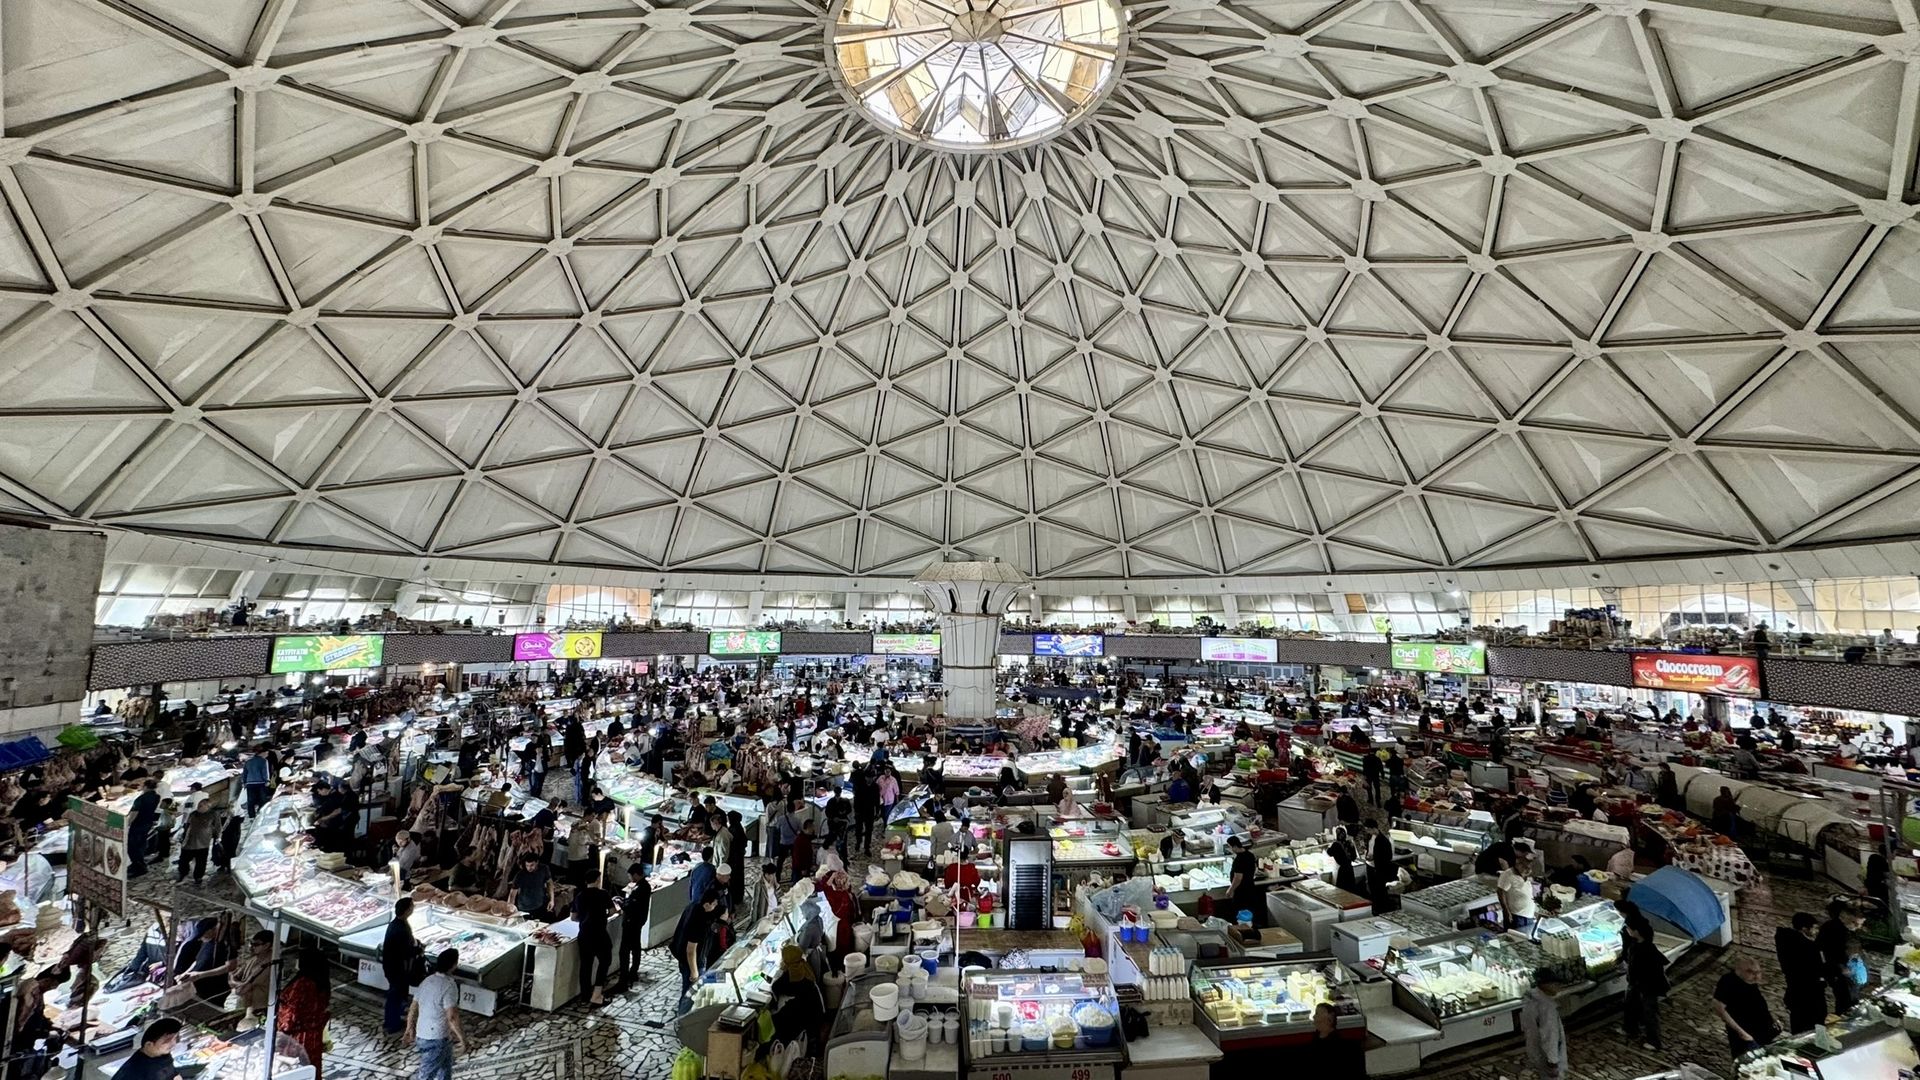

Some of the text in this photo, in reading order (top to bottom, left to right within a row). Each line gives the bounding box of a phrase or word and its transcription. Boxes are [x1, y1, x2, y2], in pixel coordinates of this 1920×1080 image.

[1656, 659, 1724, 677] Chococream
[463, 992, 476, 1003] 273
[1071, 1069, 1090, 1080] 499
